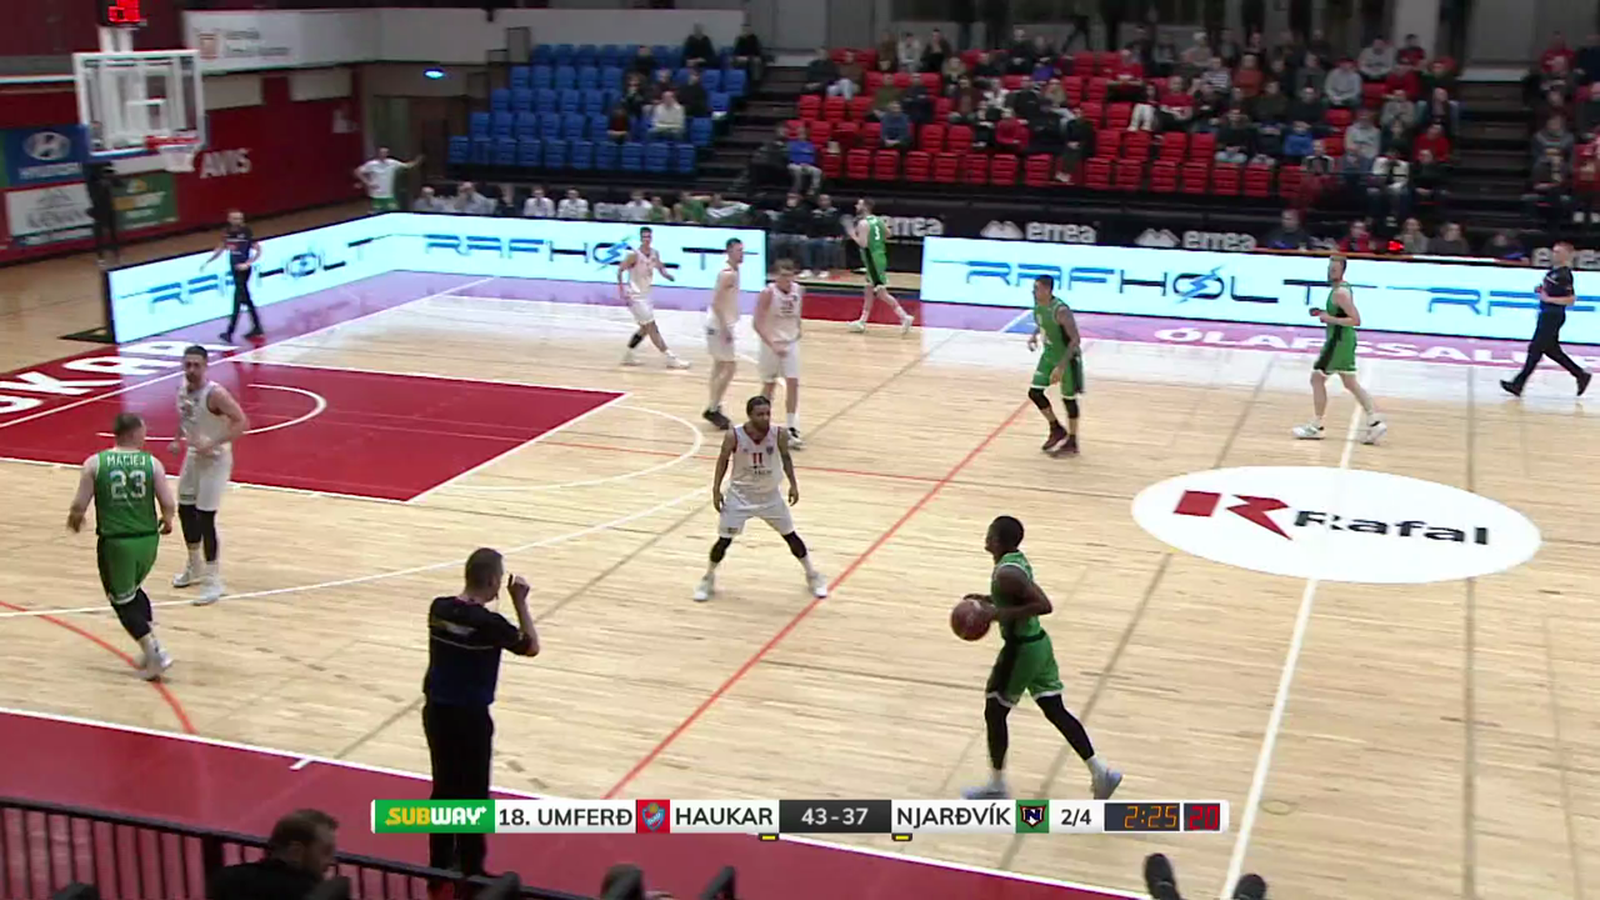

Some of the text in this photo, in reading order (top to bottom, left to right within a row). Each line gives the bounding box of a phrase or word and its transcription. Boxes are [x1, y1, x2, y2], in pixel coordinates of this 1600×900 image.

[200, 148, 252, 179] AVIS
[1025, 222, 1096, 243] errea
[1183, 230, 1257, 250] errea
[107, 454, 146, 467] MACIEJ
[110, 470, 146, 499] 23
[1294, 509, 1489, 546] Rafal
